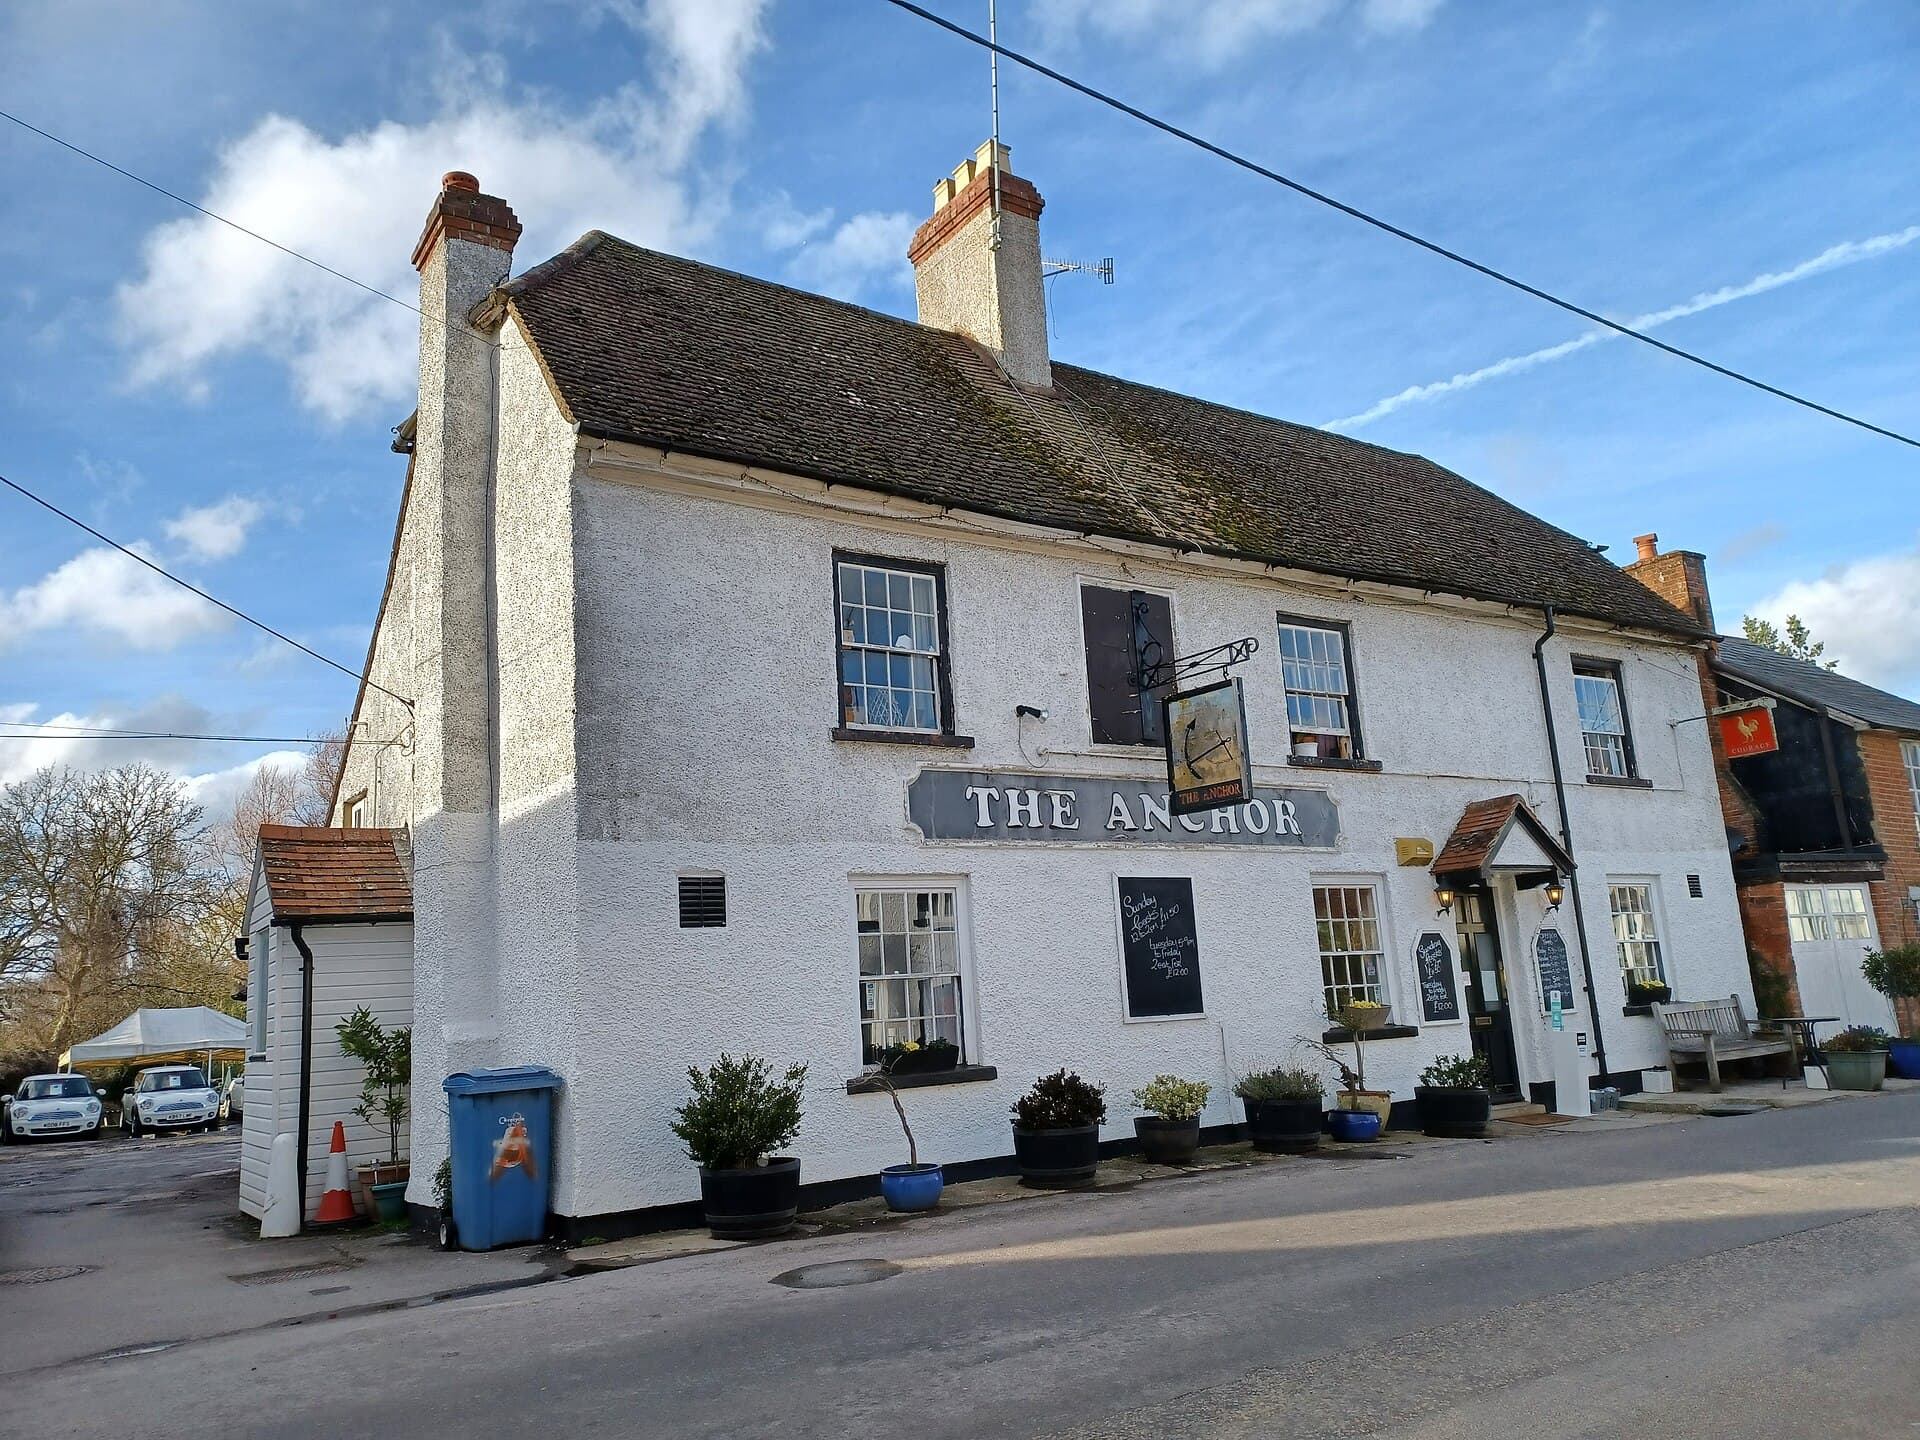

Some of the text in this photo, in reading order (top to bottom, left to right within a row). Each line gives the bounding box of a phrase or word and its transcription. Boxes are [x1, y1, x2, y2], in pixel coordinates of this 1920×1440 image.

[965, 785, 1081, 830] THE
[1179, 791, 1200, 805] THE
[1123, 892, 1158, 918] Sunday
